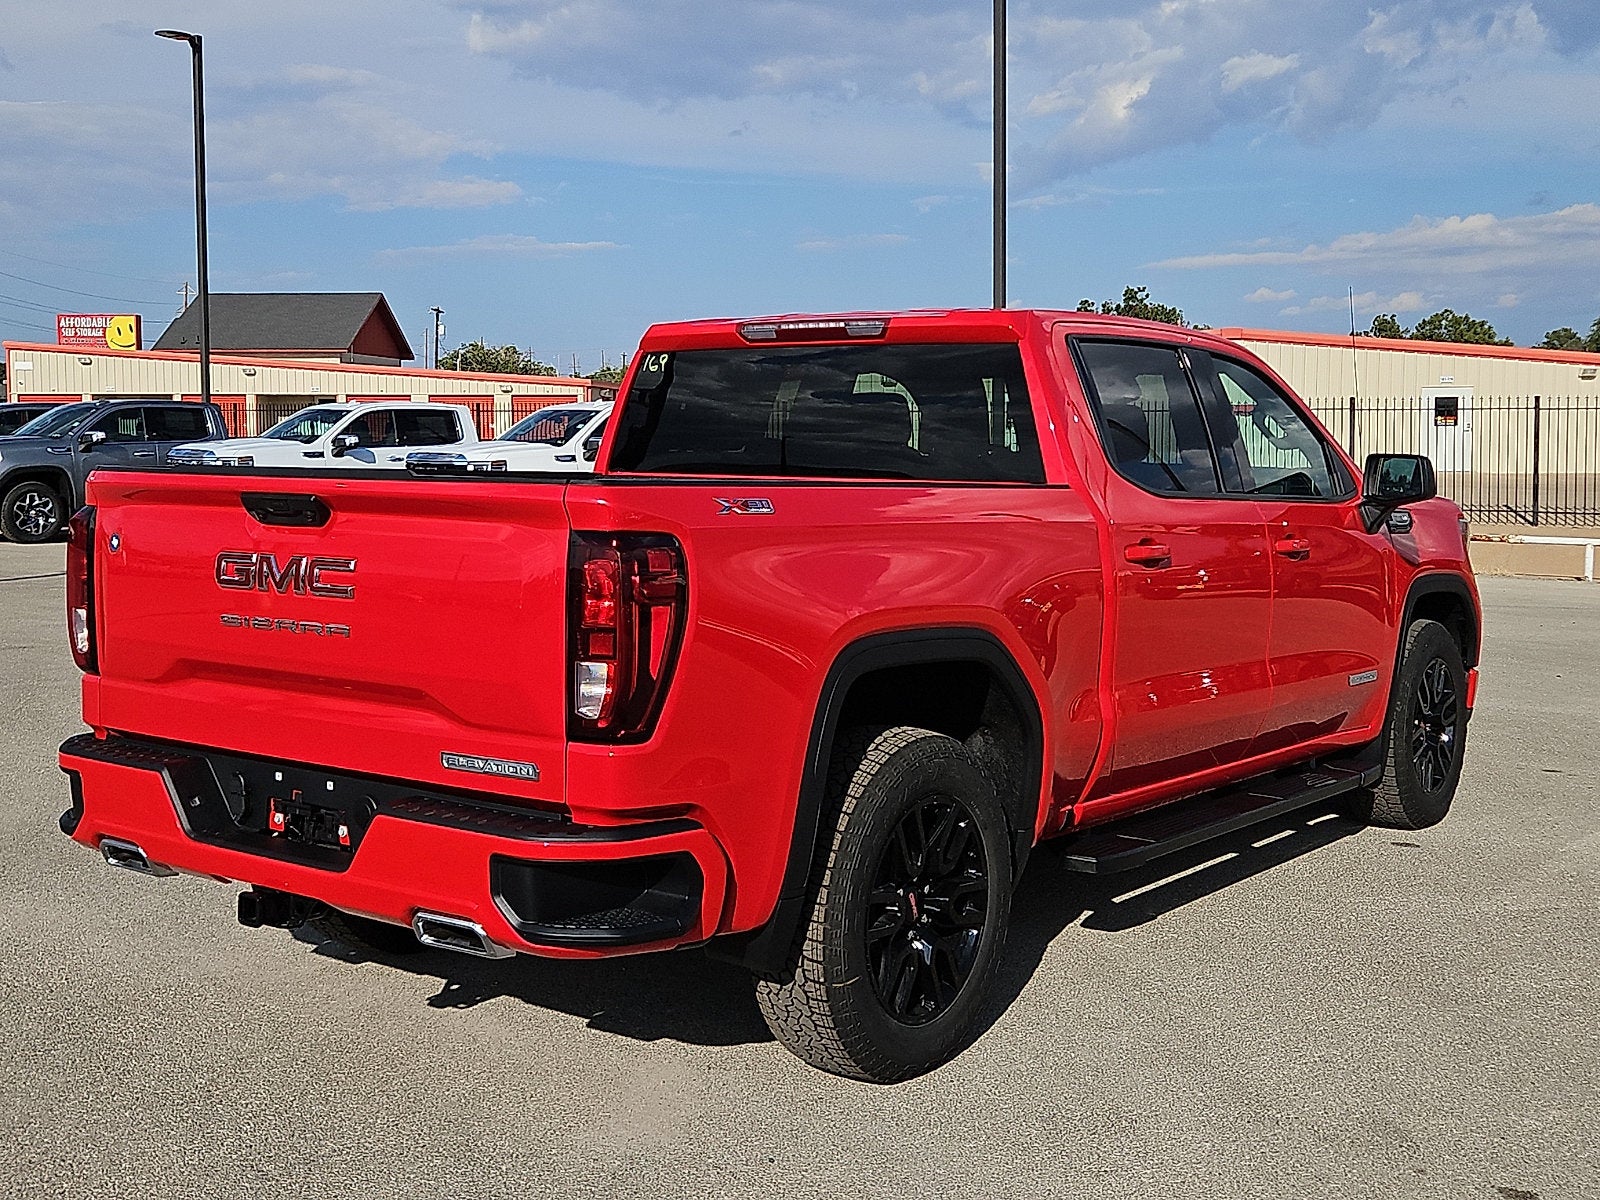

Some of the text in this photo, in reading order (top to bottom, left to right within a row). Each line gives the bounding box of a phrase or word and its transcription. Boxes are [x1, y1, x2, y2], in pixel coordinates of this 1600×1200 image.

[59, 317, 112, 328] AFFORDABLE
[61, 328, 104, 337] SELF STORAGE
[642, 353, 669, 372] 169
[215, 551, 357, 599] GMC
[220, 613, 352, 638] SIERRA
[443, 753, 537, 778] ELEVATION
